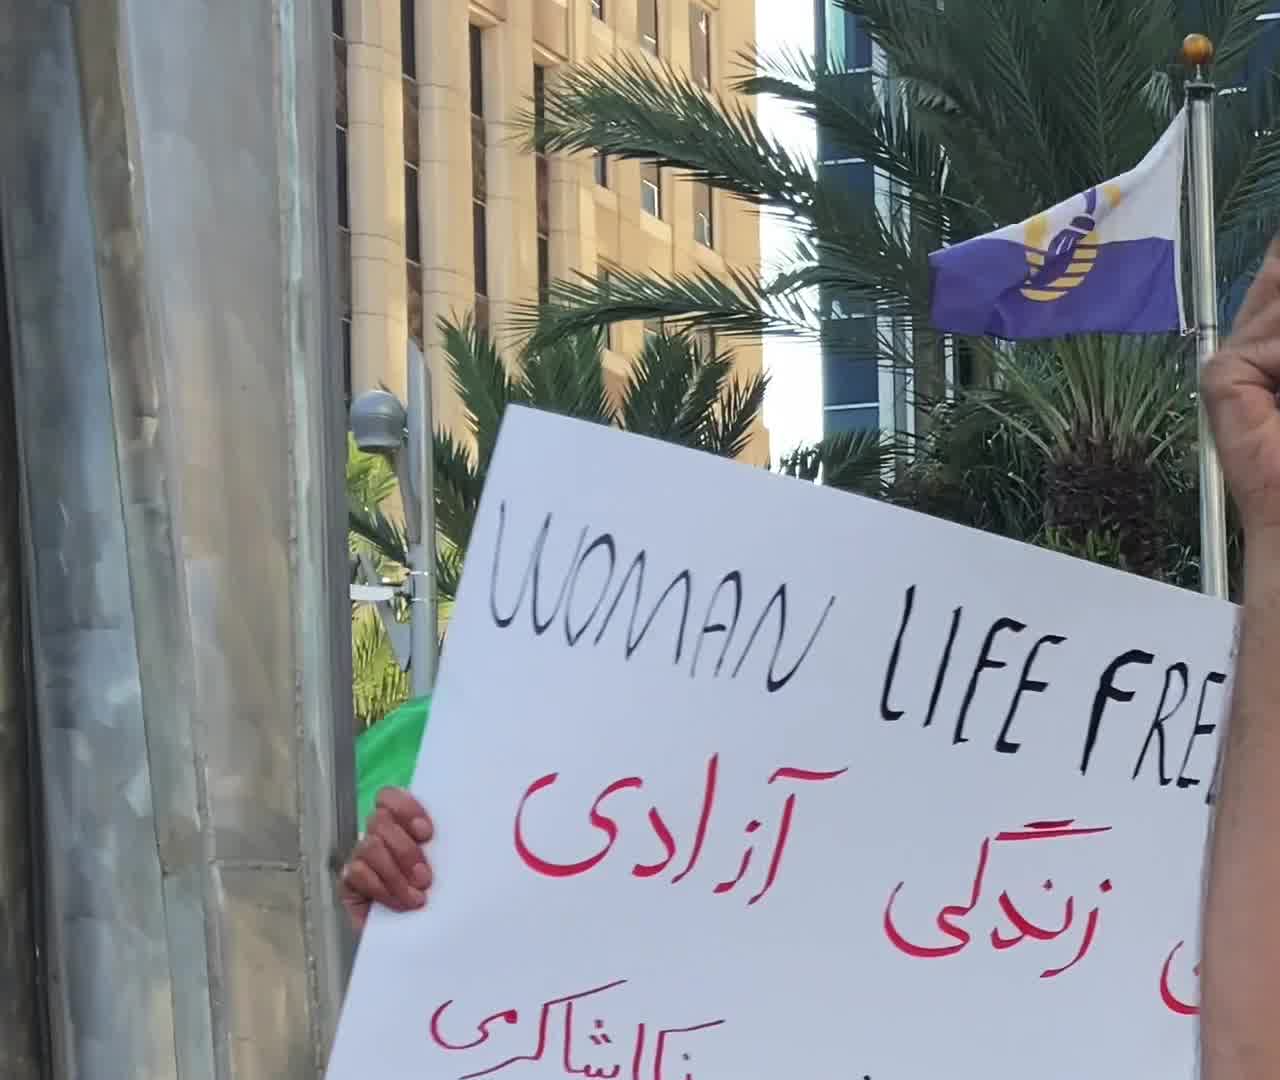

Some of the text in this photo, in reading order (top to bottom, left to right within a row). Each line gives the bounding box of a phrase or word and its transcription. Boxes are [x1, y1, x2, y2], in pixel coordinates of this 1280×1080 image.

[490, 500, 1227, 805] WOMAN LIFE FRE
[514, 753, 848, 905] آزادی
[884, 819, 1113, 978] زندگی
